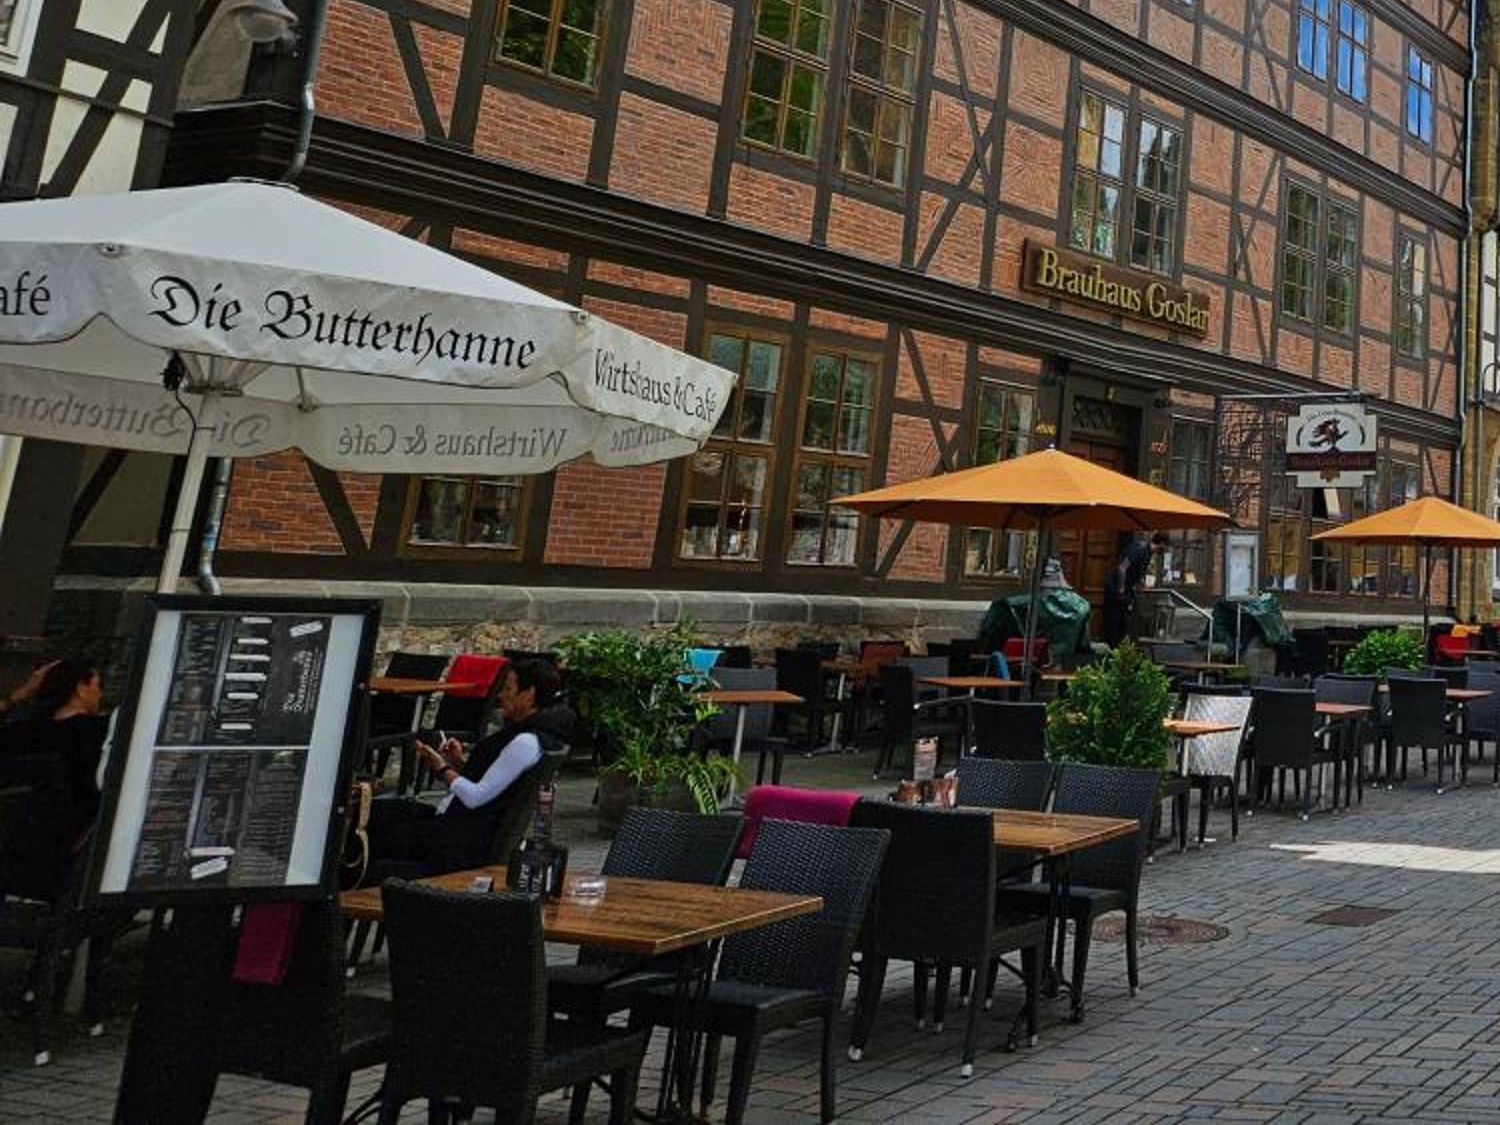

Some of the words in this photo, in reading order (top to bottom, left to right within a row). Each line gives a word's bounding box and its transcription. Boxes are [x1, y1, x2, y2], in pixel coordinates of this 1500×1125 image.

[147, 274, 242, 332] Die
[259, 290, 536, 369] Butterhanne
[1037, 248, 1141, 312] Brauhaus
[1146, 281, 1210, 331] Goslar
[593, 347, 672, 407] Wirtshaus
